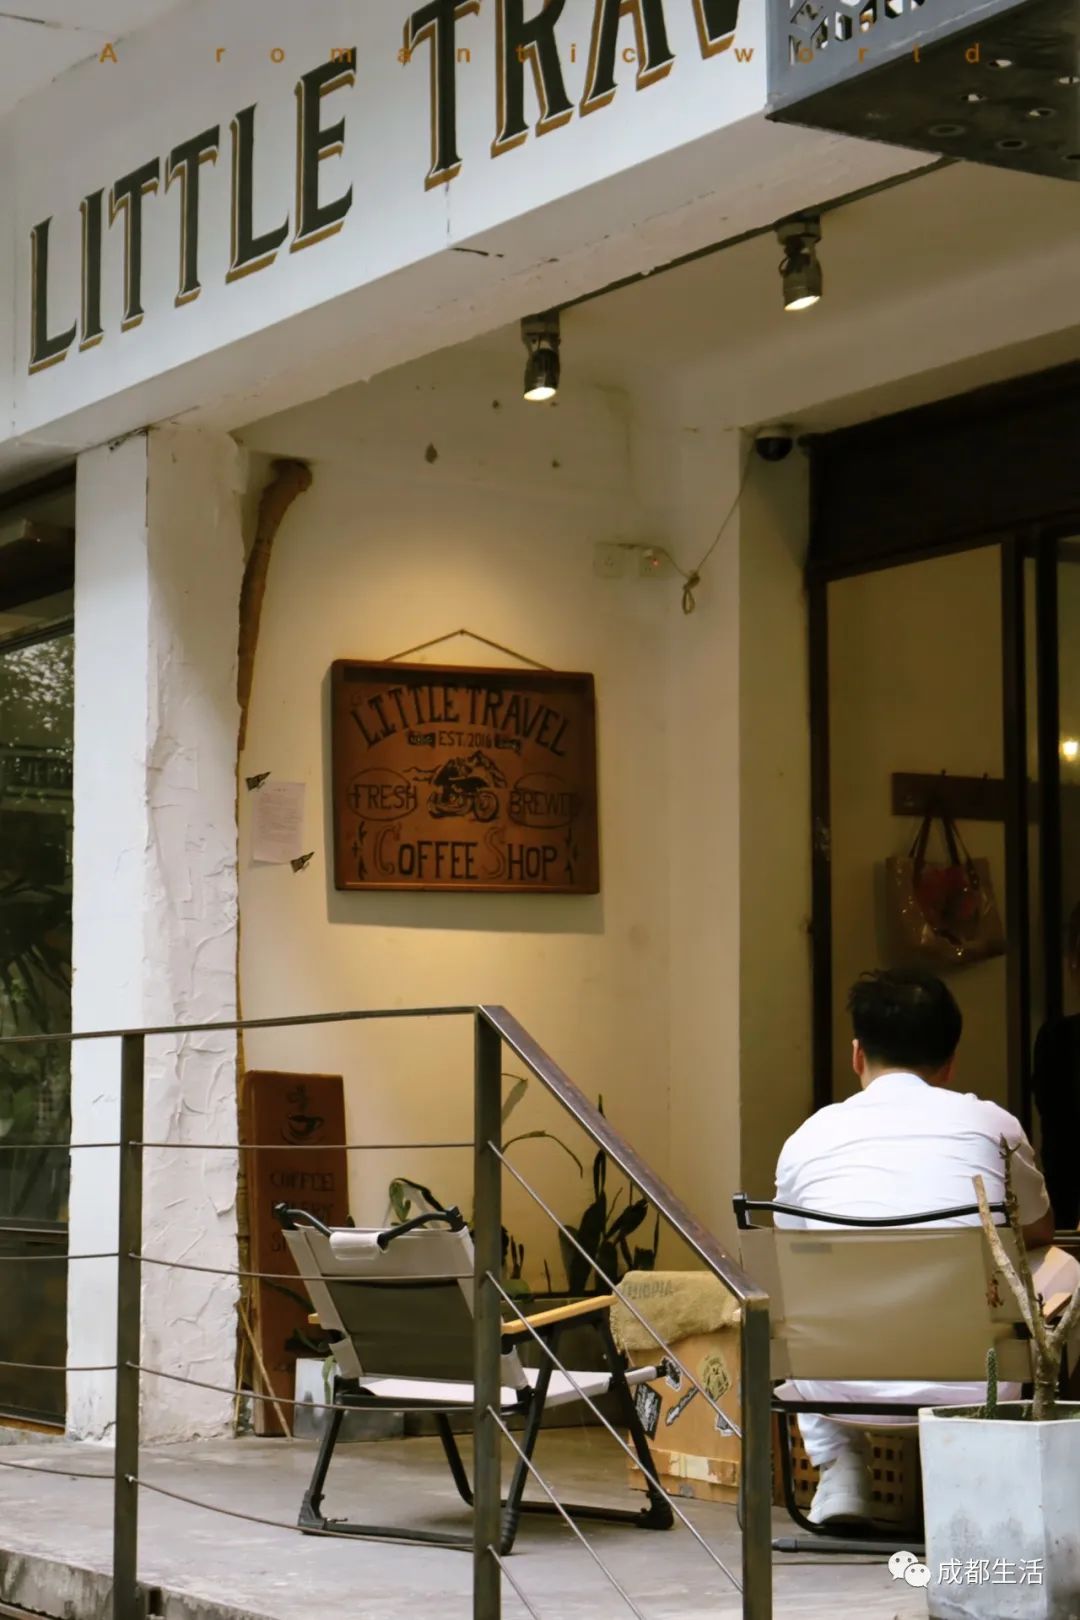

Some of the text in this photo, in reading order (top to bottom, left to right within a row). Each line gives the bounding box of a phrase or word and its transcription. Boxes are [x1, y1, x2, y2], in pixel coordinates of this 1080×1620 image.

[28, 47, 360, 375] LITTLE
[351, 683, 572, 758] LITTLE TRAVEL
[349, 784, 418, 810] FRESH
[373, 824, 559, 882] COFFEE SHOP
